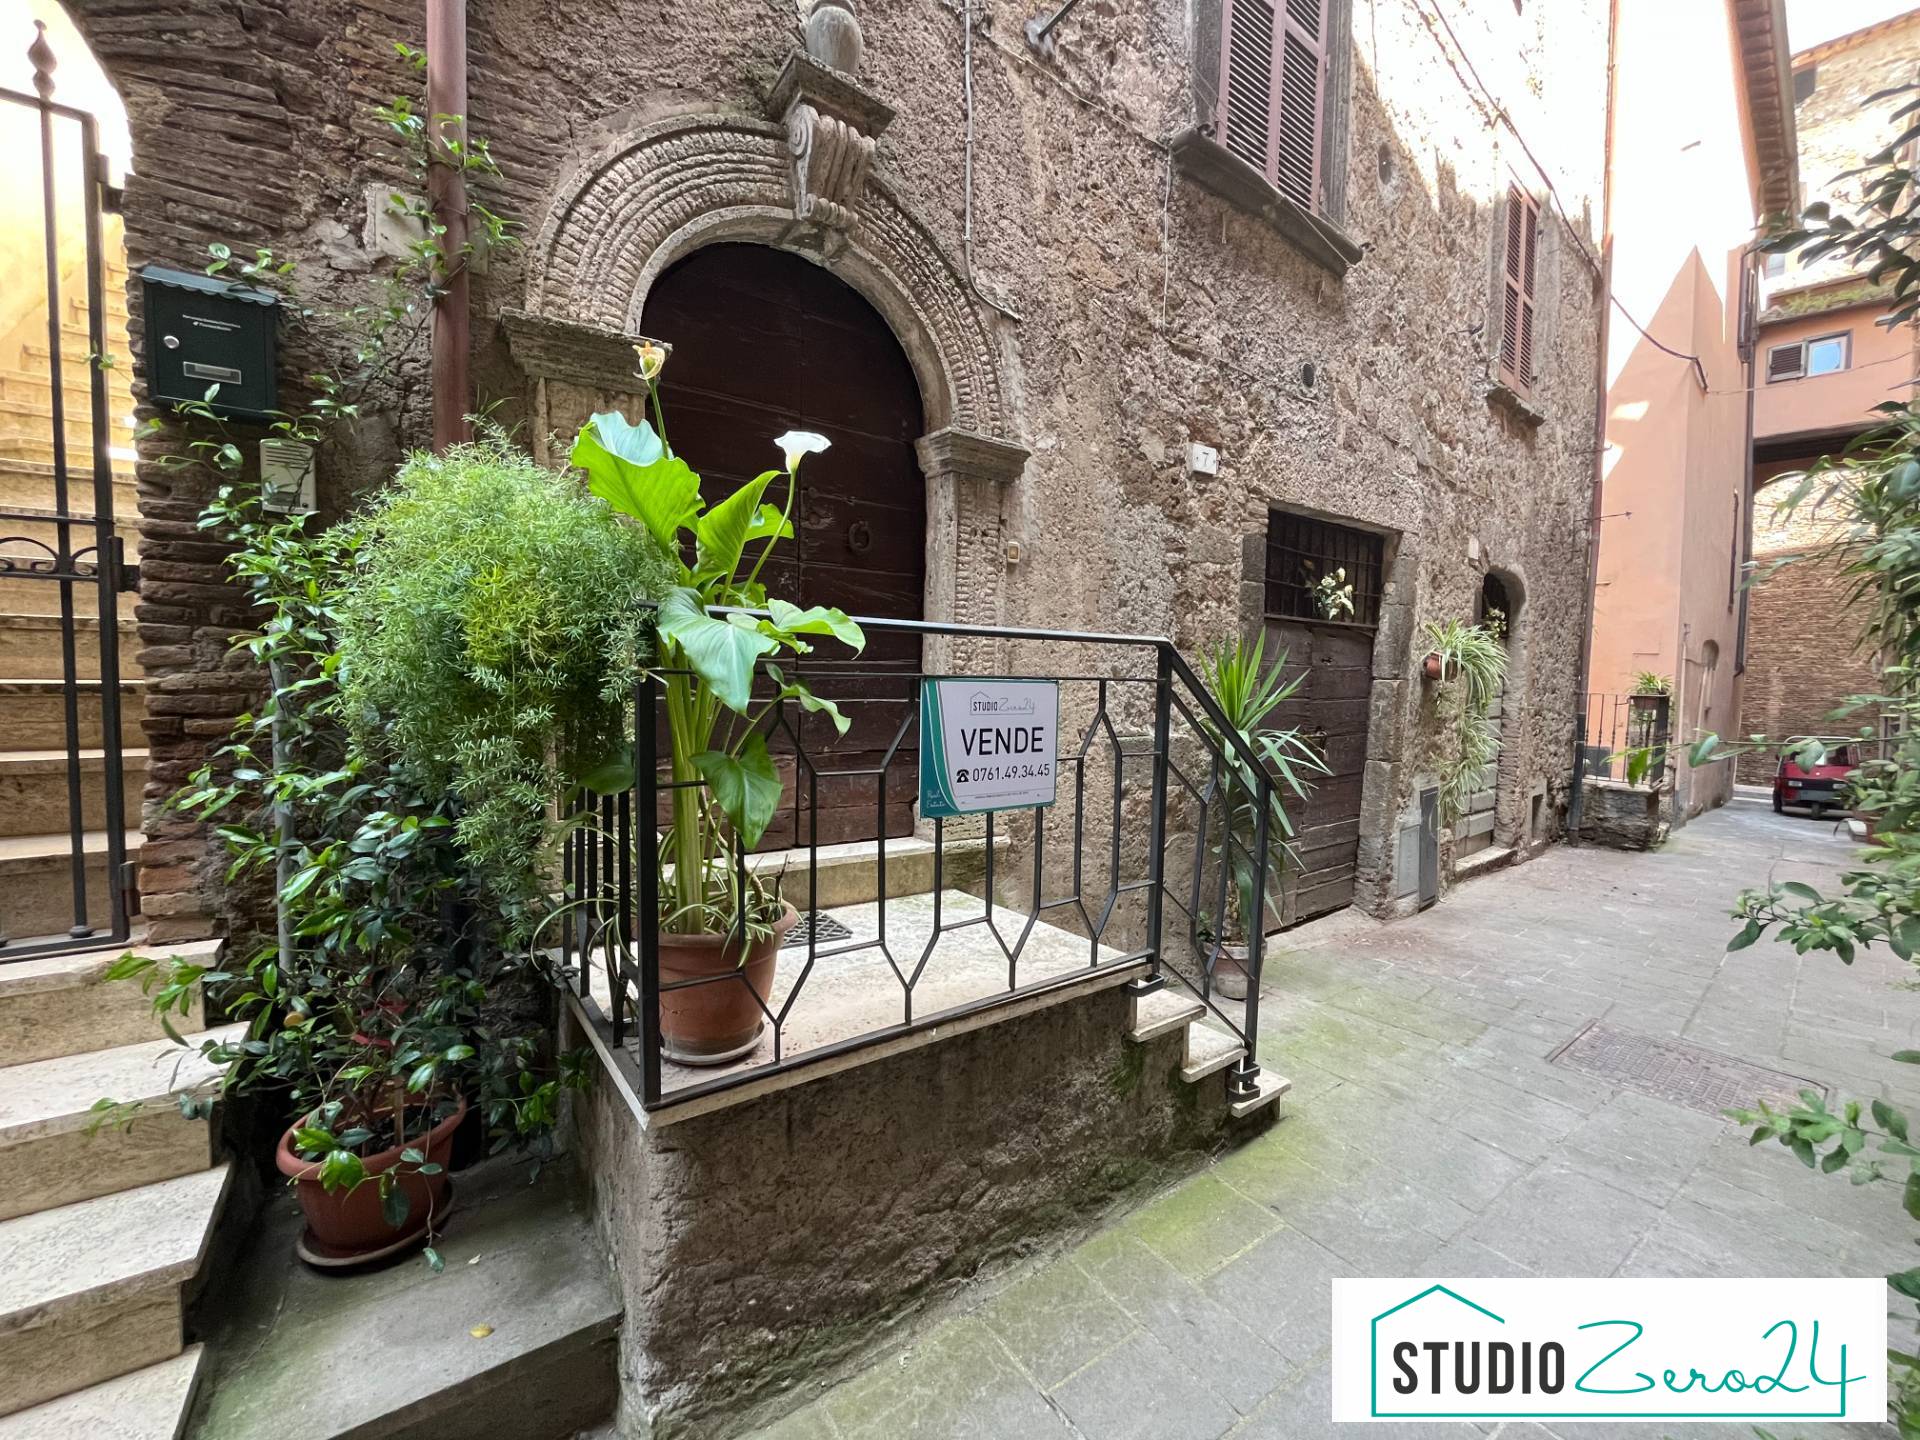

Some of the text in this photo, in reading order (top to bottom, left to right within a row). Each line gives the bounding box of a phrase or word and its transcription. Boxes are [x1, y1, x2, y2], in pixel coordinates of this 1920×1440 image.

[972, 701, 998, 712] STUDIO
[961, 726, 1044, 756] VENDE
[972, 763, 1050, 782] 0761.49.34.45
